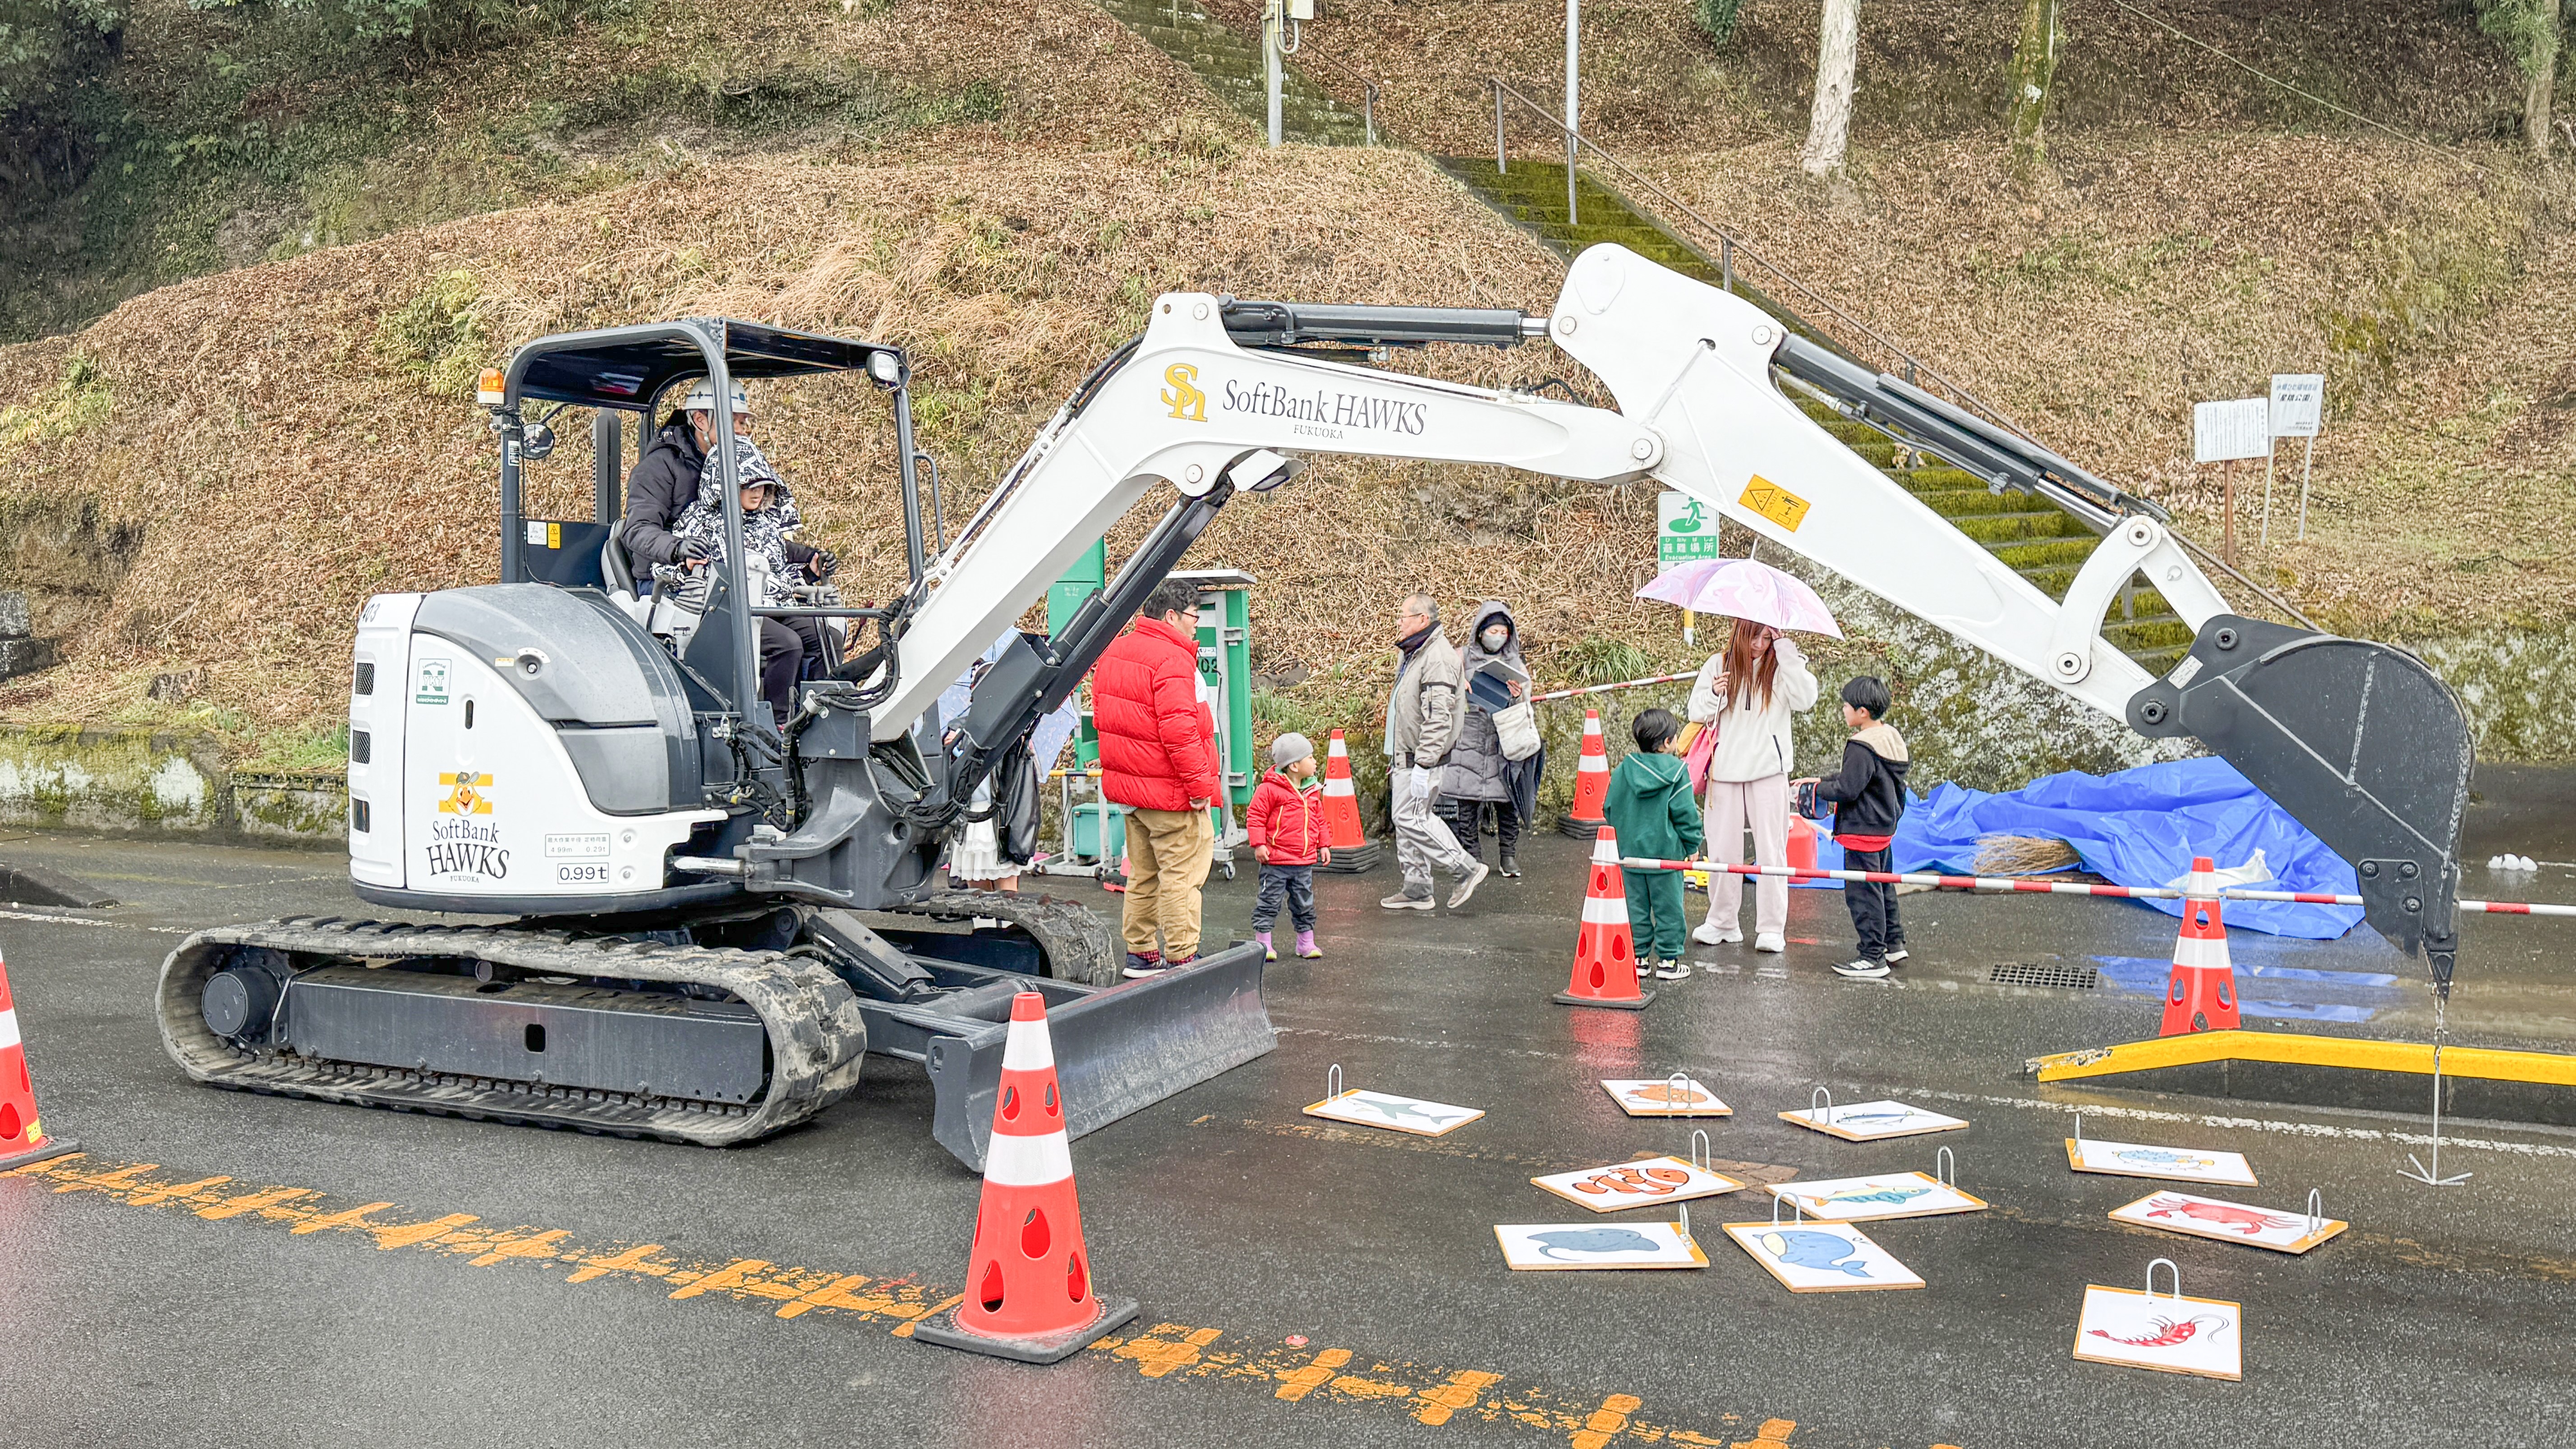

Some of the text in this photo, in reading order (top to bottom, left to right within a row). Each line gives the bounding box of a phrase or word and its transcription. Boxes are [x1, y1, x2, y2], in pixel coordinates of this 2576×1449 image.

[1223, 379, 1427, 436] SoftBank HAWKS
[1294, 424, 1343, 439] FUKUOKA
[1663, 542, 1714, 553] 避難場所
[423, 676, 445, 687] YKT
[432, 818, 500, 844] SoftBank
[426, 842, 510, 879] HAWKS
[560, 866, 607, 880] 0.99t
